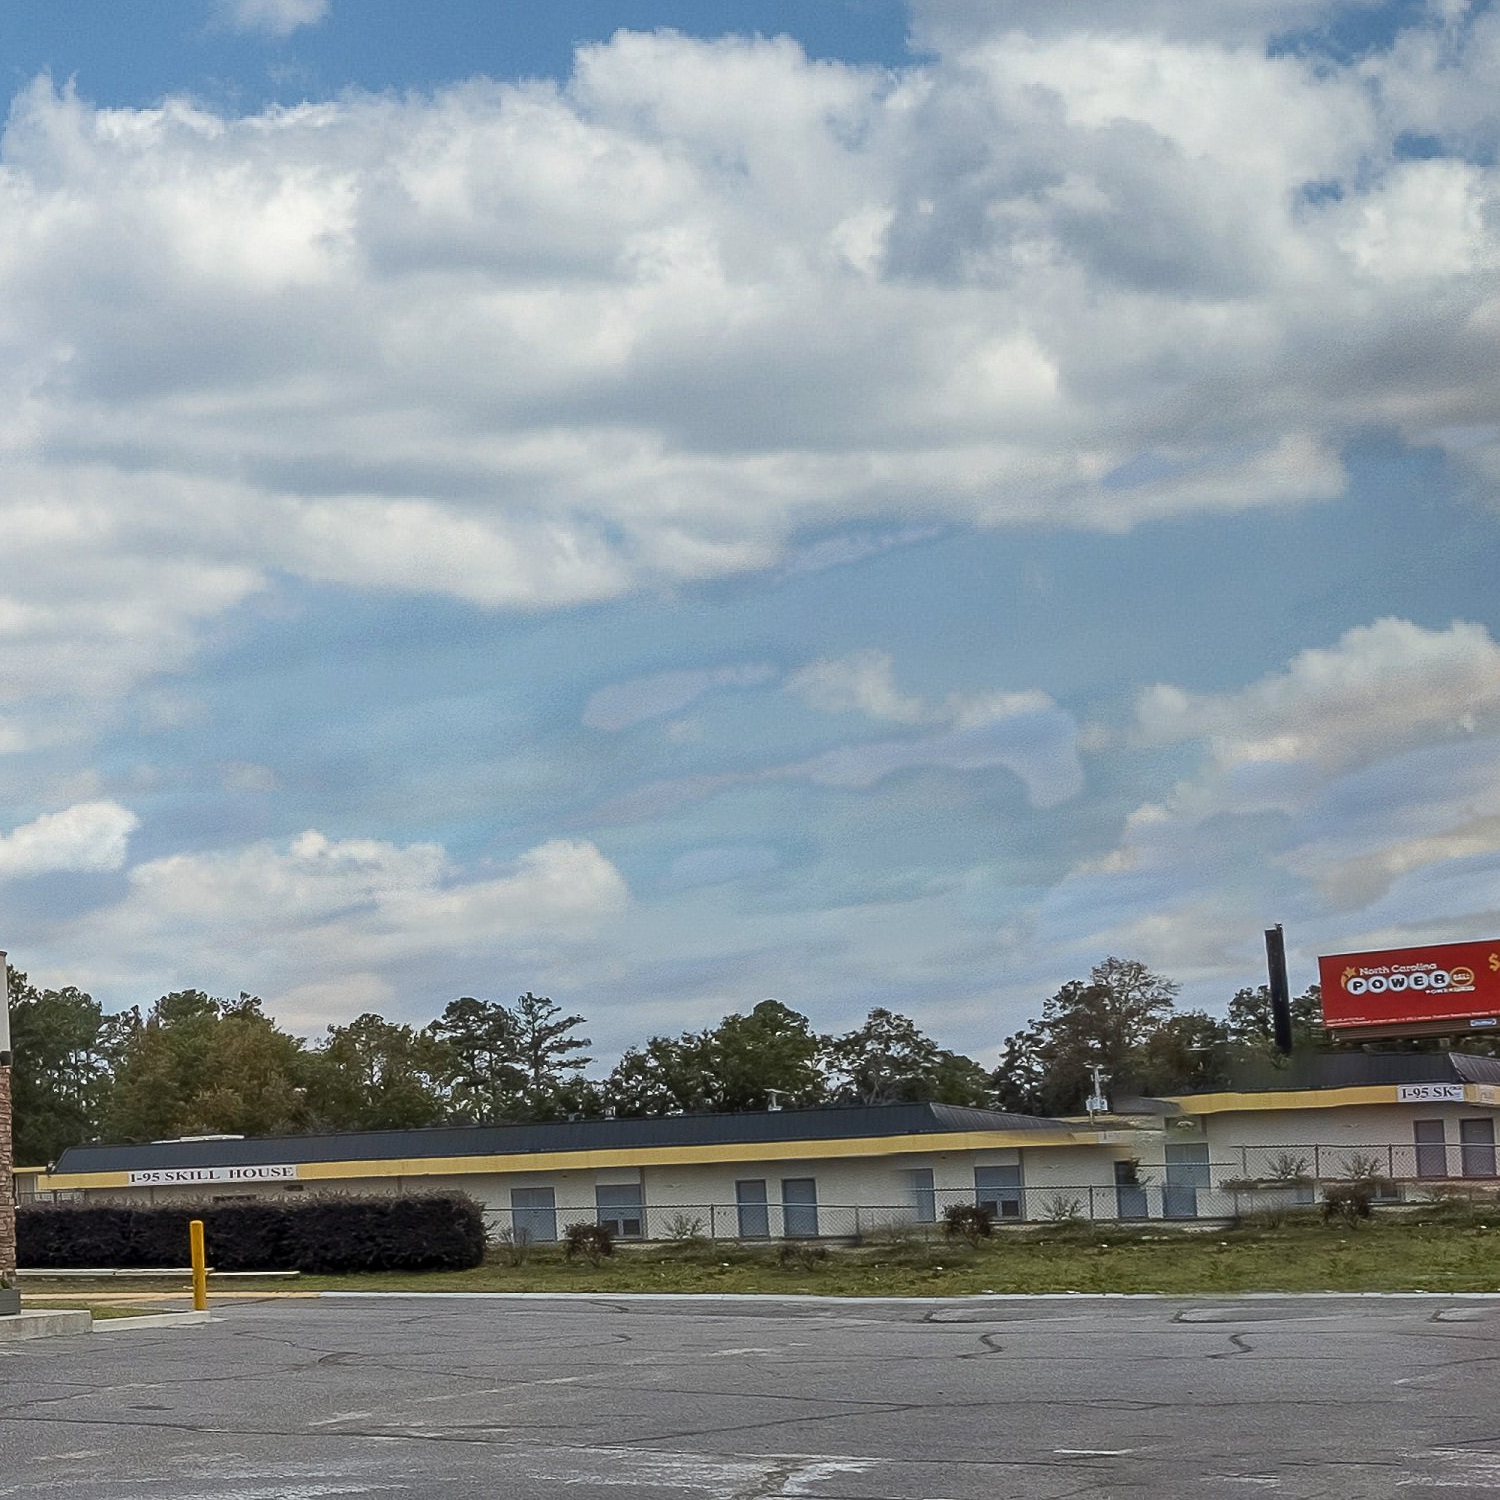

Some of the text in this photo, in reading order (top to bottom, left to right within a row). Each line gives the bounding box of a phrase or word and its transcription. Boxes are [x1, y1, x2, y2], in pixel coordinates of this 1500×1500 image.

[1359, 963, 1438, 976] North Carolina
[1401, 1087, 1429, 1099] I-95
[130, 1166, 294, 1183] I-95 SKILL HOUSE
